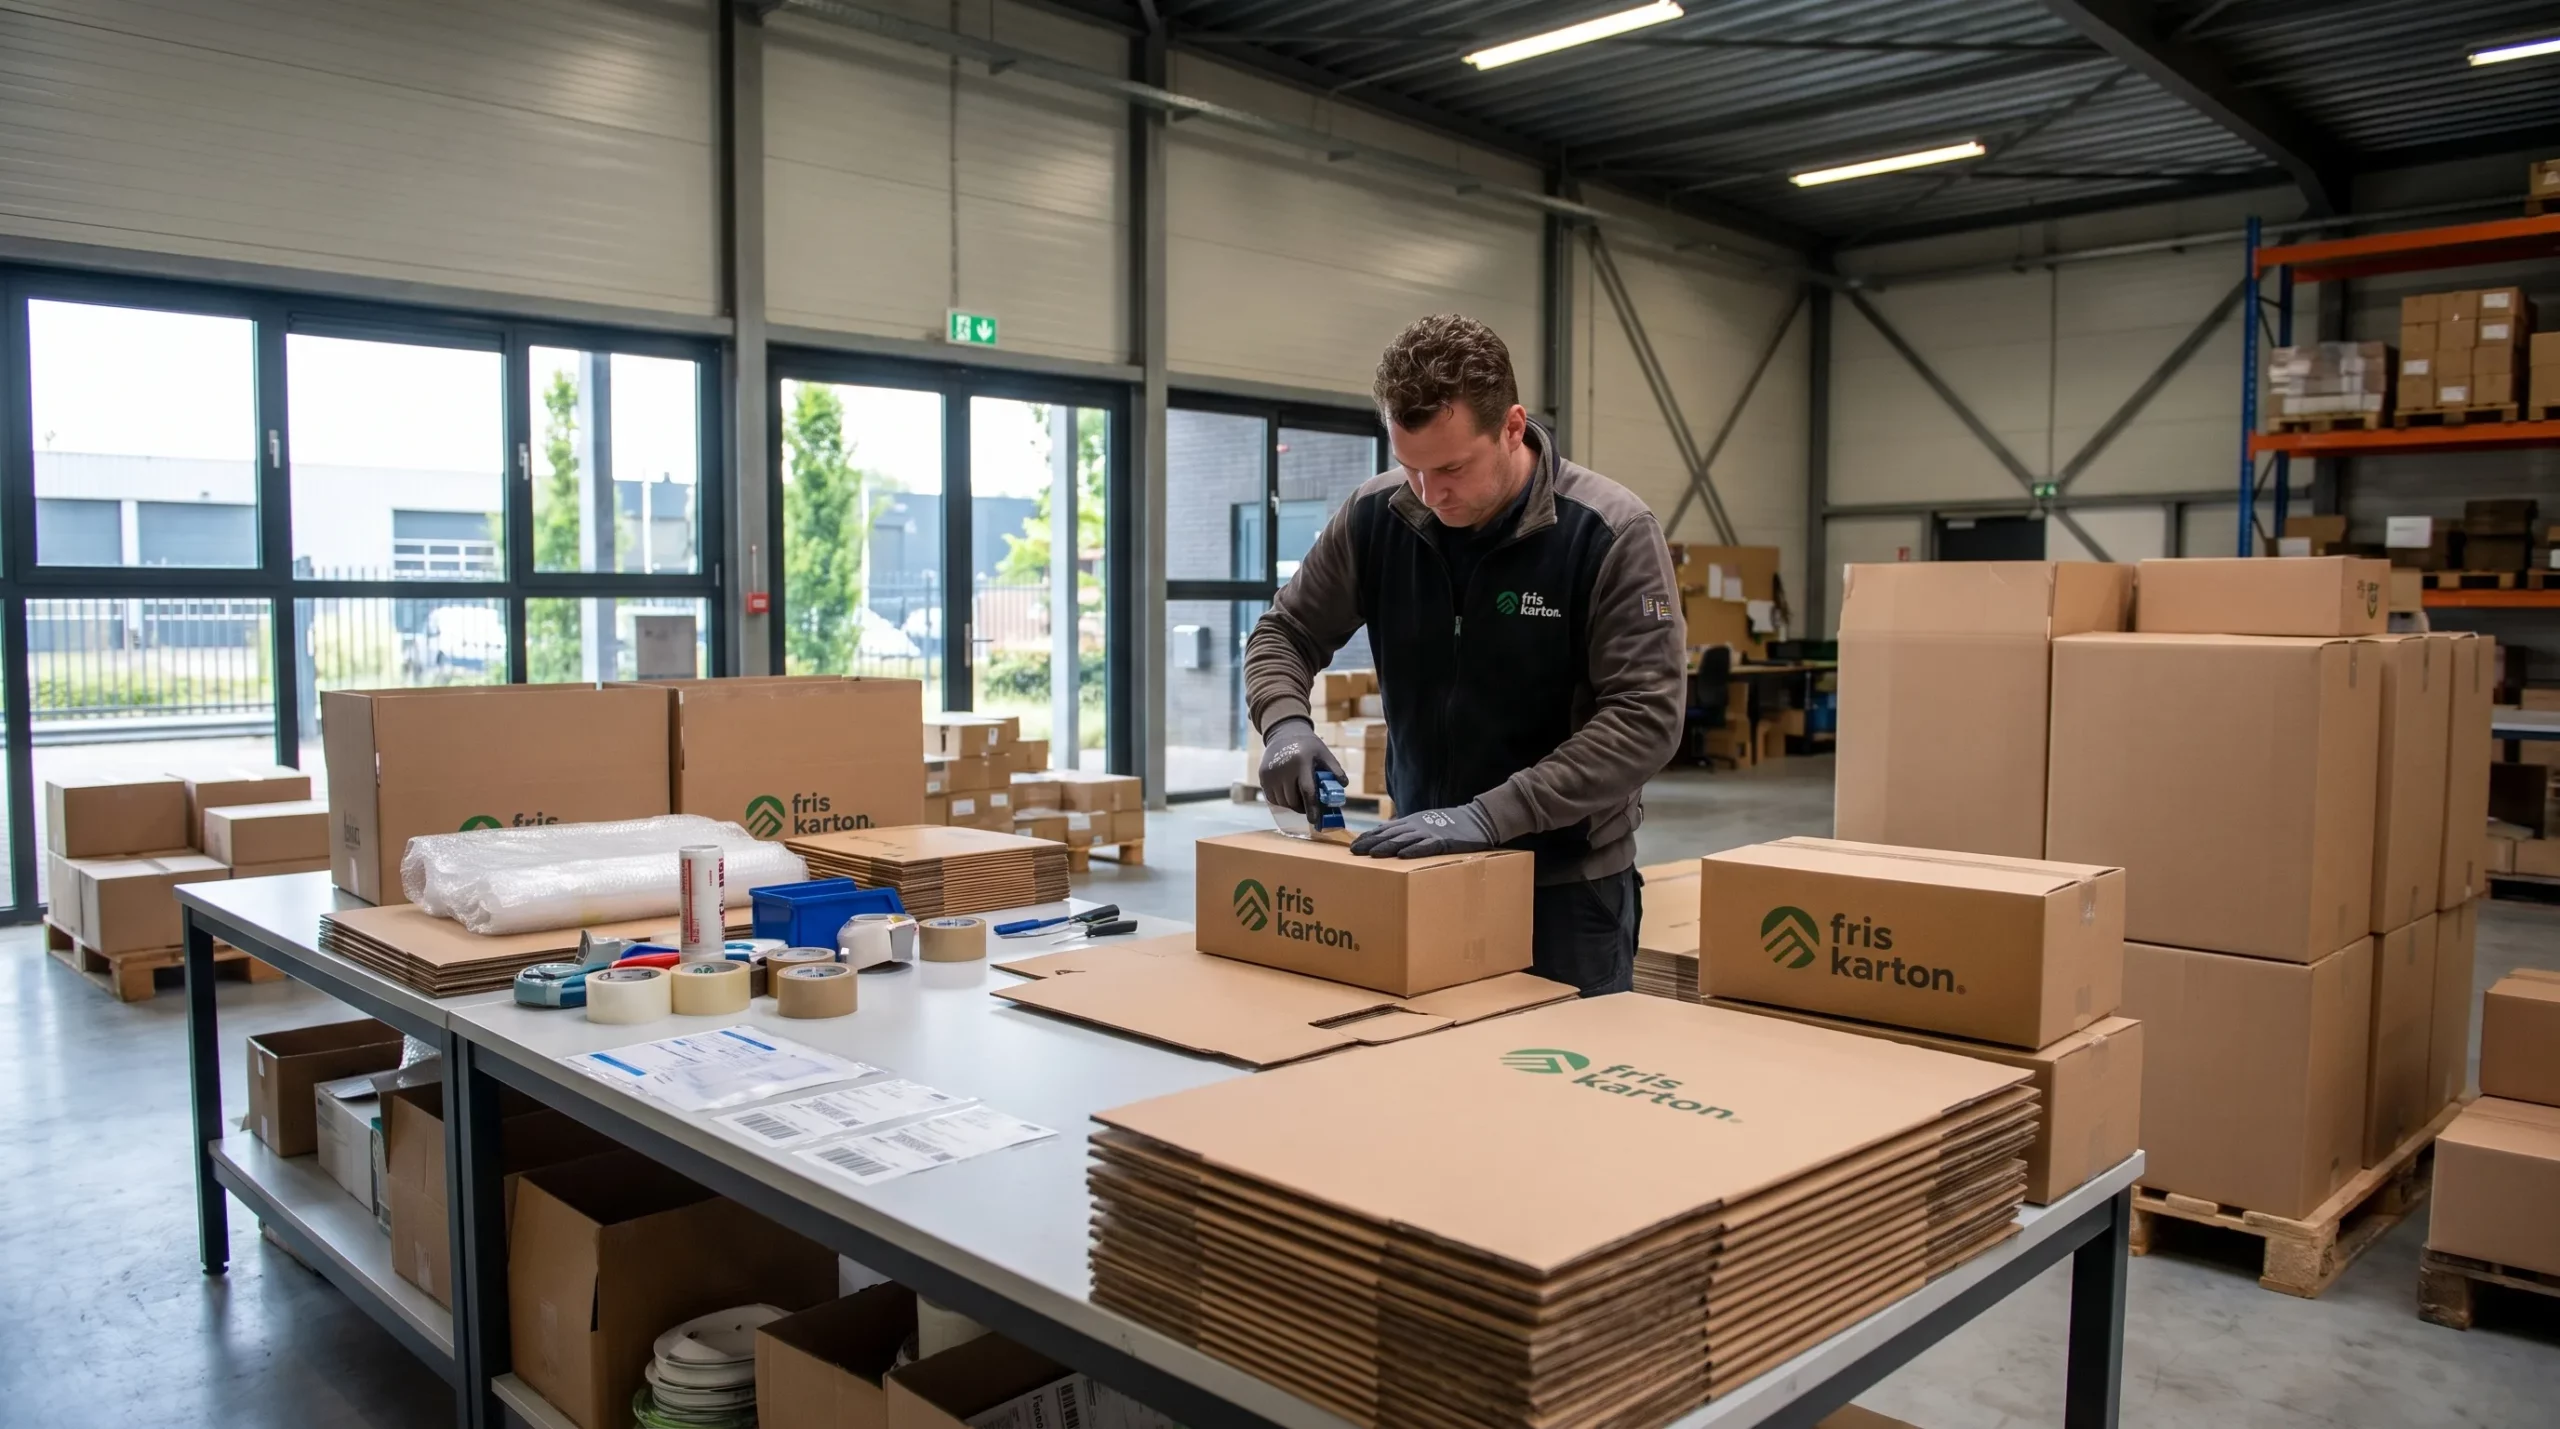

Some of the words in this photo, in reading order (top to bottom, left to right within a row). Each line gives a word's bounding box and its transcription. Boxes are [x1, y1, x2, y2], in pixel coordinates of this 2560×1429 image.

[1521, 591, 1544, 605] fris
[1520, 603, 1562, 618] karton.
[792, 792, 831, 814] fris
[1276, 885, 1314, 915] fris
[1830, 912, 1893, 951] fris
[1599, 1064, 1684, 1090] fris
